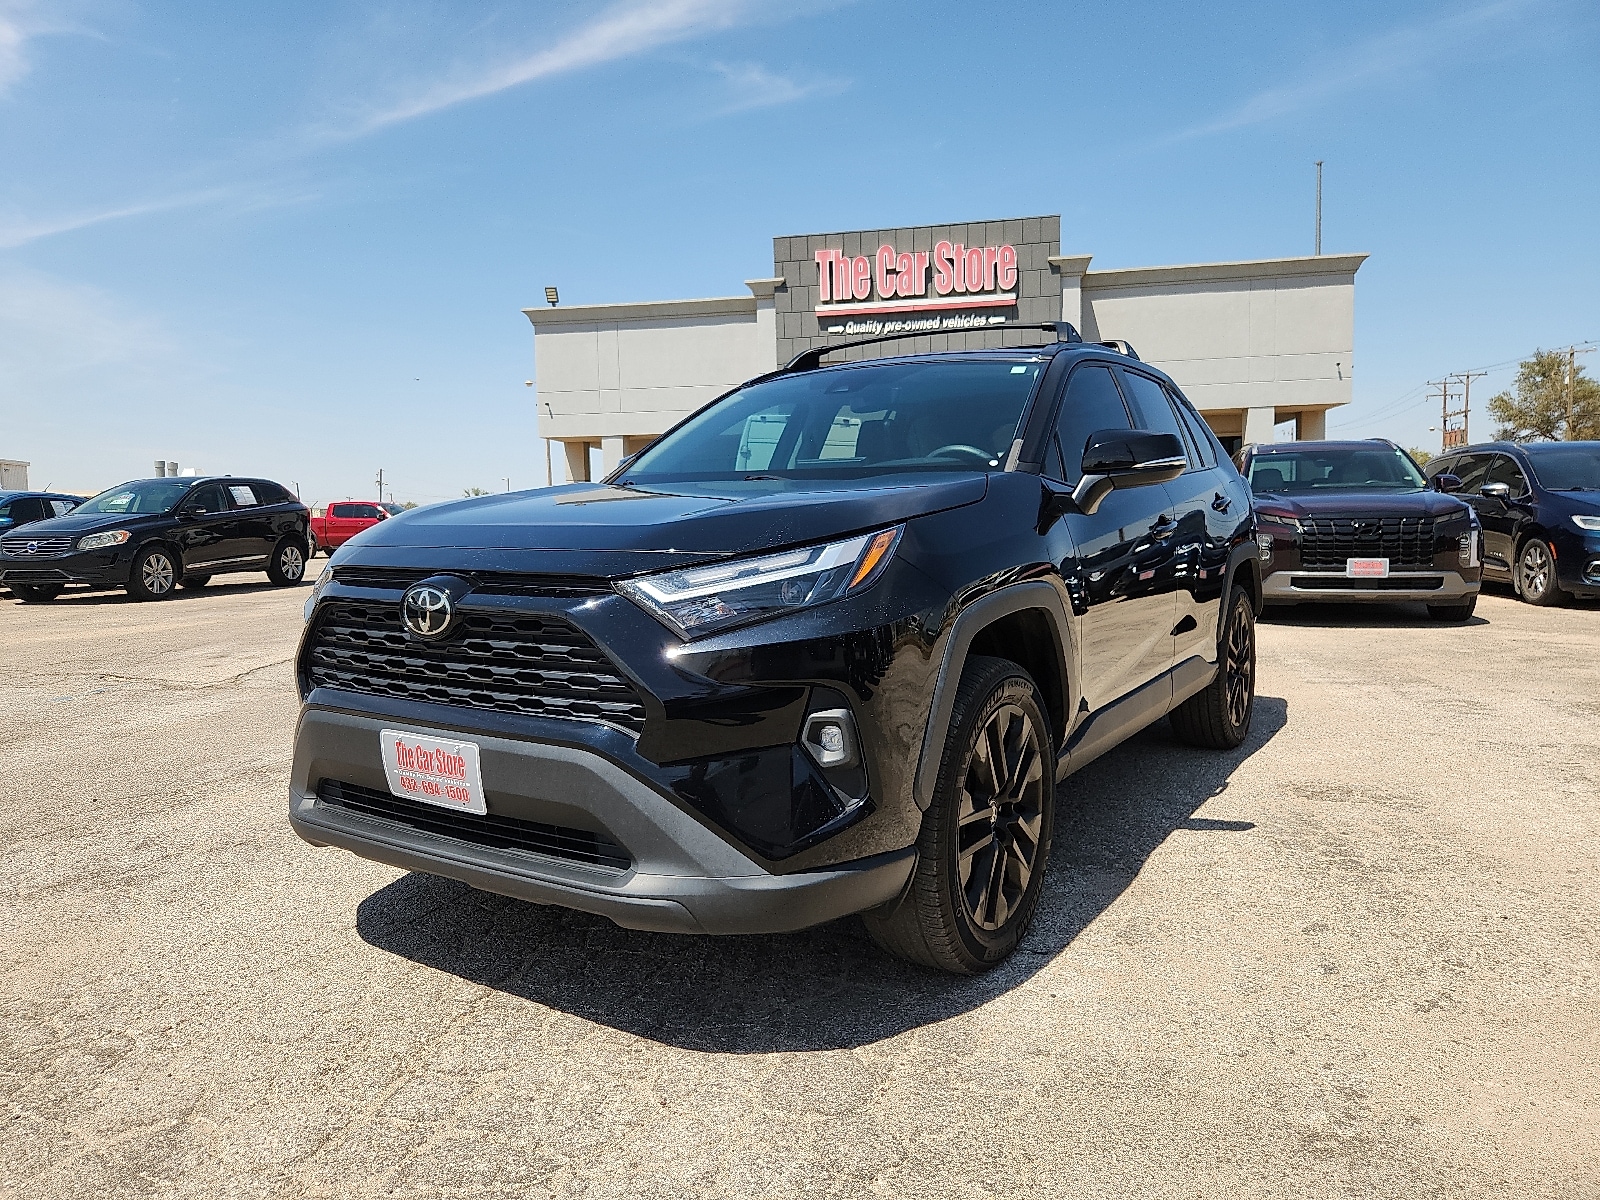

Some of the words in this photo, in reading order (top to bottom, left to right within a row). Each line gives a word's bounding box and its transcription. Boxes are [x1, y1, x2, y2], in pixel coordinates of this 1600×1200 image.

[815, 249, 871, 301] The
[876, 245, 930, 299] Car
[933, 240, 1018, 295] Store
[845, 320, 882, 335] Quality
[884, 315, 941, 335] pre-owned
[942, 313, 987, 328] vehicles
[395, 740, 415, 770] The
[415, 744, 435, 773] Car
[435, 747, 466, 778] Store
[400, 776, 471, 803] 432-694-1500
